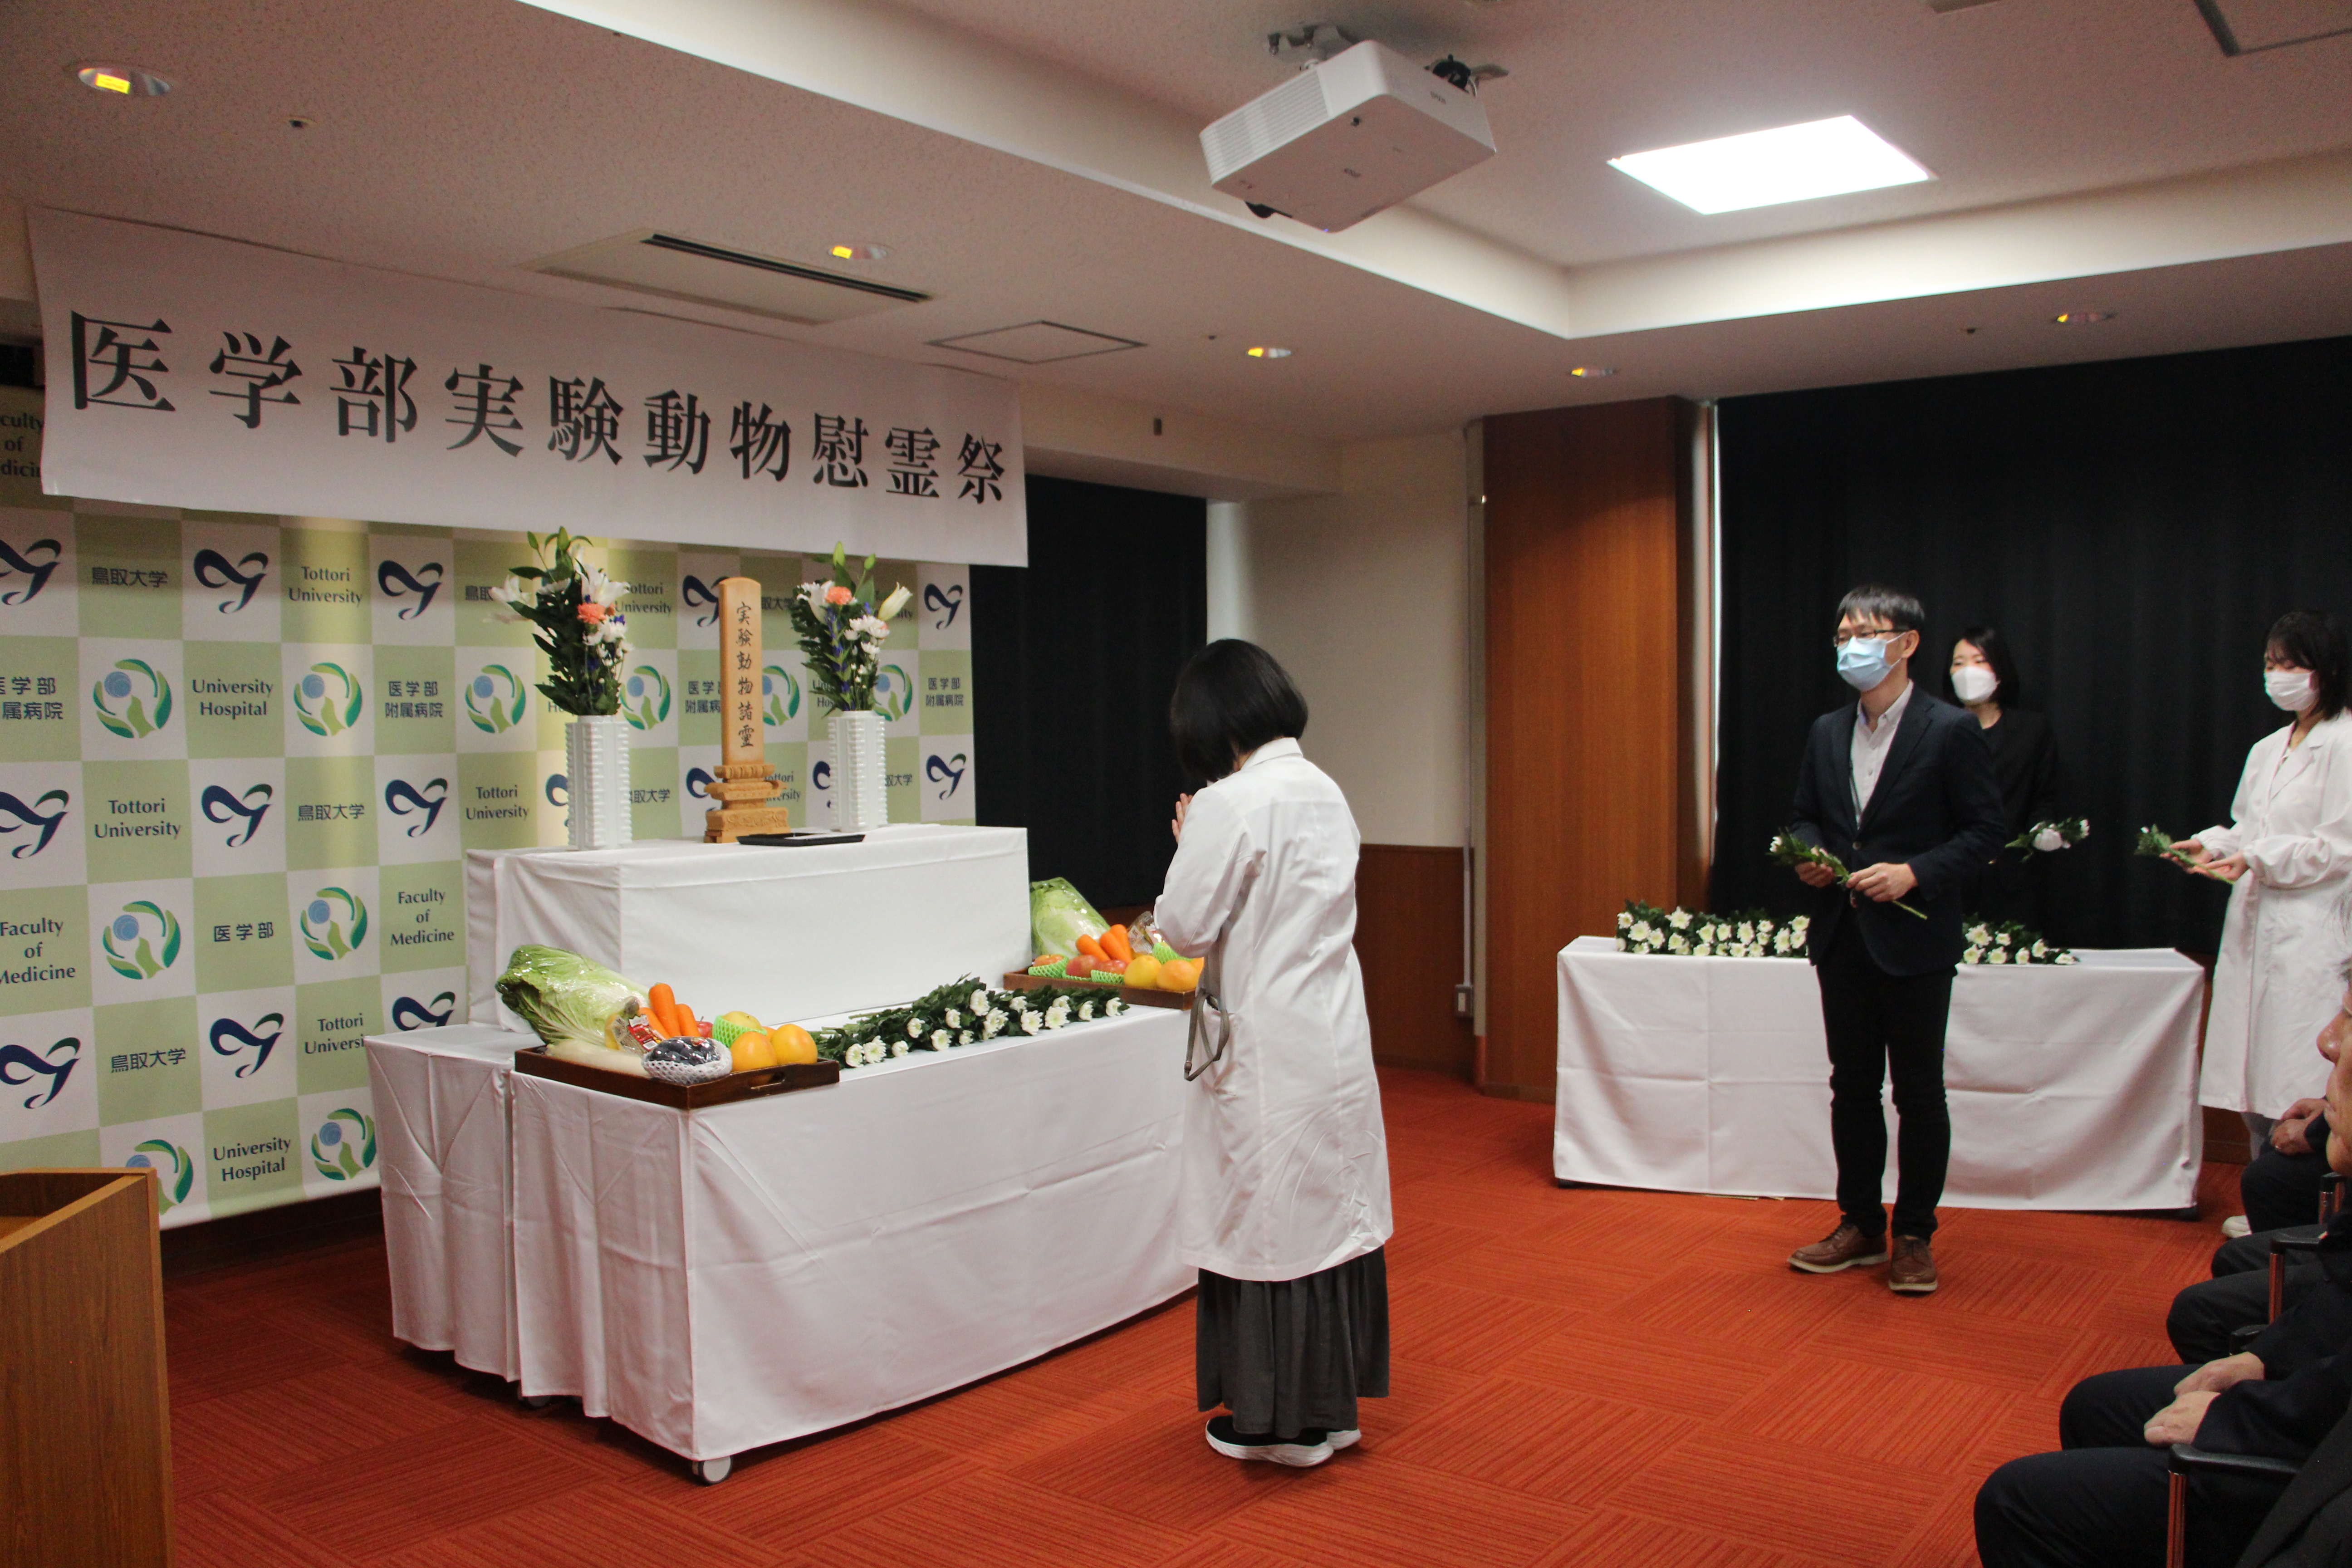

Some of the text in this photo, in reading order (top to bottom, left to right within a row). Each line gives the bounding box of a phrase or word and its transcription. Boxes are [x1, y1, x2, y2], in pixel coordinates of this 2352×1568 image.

[71, 310, 1005, 505] 医学部実験動物慰霊祭
[0, 412, 44, 434] culty
[4, 436, 25, 452] of
[92, 567, 168, 588] 鳥取大学
[301, 566, 350, 581] Tottori
[288, 586, 363, 605] University
[465, 585, 493, 601] 鳥取
[630, 582, 663, 594] ottori
[615, 599, 671, 617] University
[761, 596, 795, 610] 取大学
[192, 678, 274, 697] University
[389, 681, 438, 696] 医学部
[688, 681, 720, 695] 医学
[928, 677, 960, 690] 医学部
[685, 700, 720, 713] 附属病
[926, 694, 964, 707] 附属病院
[0, 702, 64, 720] 属病院
[201, 701, 266, 720] Hospital
[385, 702, 443, 718] 附属病院
[764, 770, 794, 782] ottori
[884, 774, 912, 786] 取大学
[476, 785, 517, 799] Tottori
[630, 789, 671, 803] 取大学
[108, 798, 165, 814] Tottori
[298, 804, 364, 821] 鳥取大学
[466, 804, 529, 823] University
[94, 820, 181, 838] University
[398, 888, 445, 906] Faculty
[416, 909, 430, 923] of
[0, 918, 63, 936] Faculty
[214, 922, 273, 942] 医学部
[391, 929, 454, 945] Medicine
[24, 941, 43, 958] of
[317, 1012, 363, 1032] Tottori
[304, 1033, 364, 1054] Universi
[112, 1048, 186, 1073] 鳥取大学
[213, 1136, 291, 1161] University
[221, 1156, 285, 1181] Hospital
